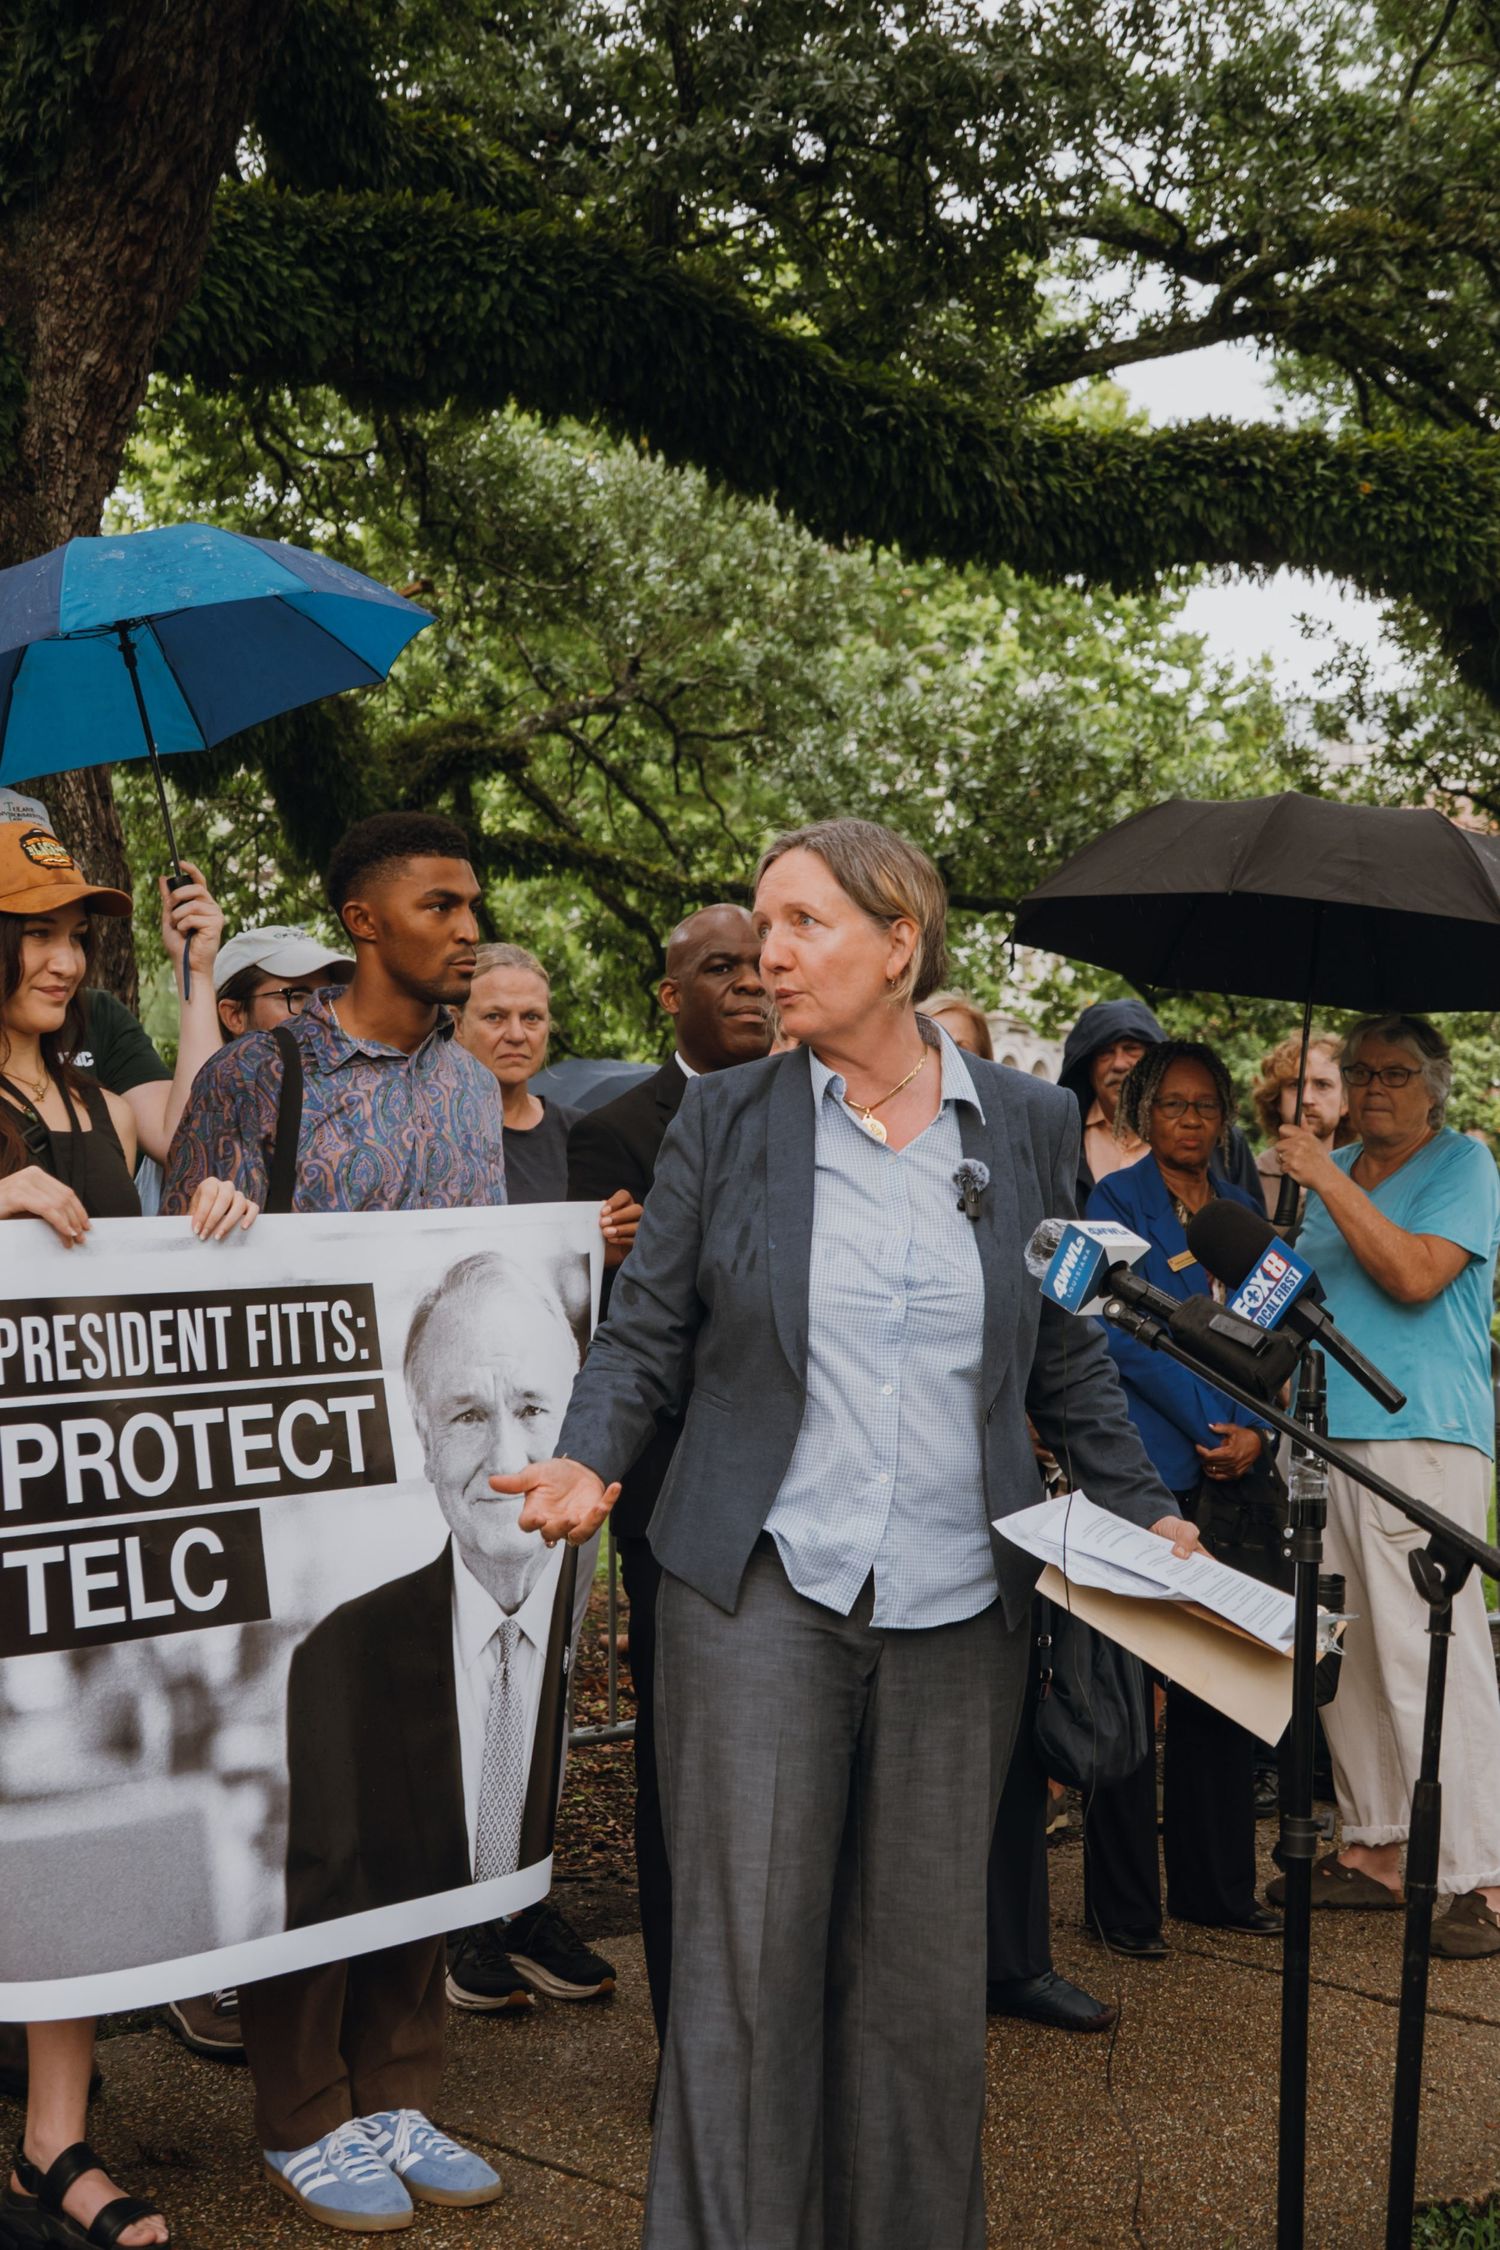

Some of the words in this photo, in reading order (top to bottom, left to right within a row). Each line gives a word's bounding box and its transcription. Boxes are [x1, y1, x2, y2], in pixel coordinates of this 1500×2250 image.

[1067, 1249, 1091, 1298] LOUISIANA
[1256, 1298, 1280, 1327] OCAL
[1274, 1269, 1300, 1302] FIRST
[0, 1306, 232, 1386] PRESIDENT
[246, 1299, 370, 1368] FITTS:
[0, 1394, 376, 1512] PROTECT
[3, 1527, 228, 1635] TELC
